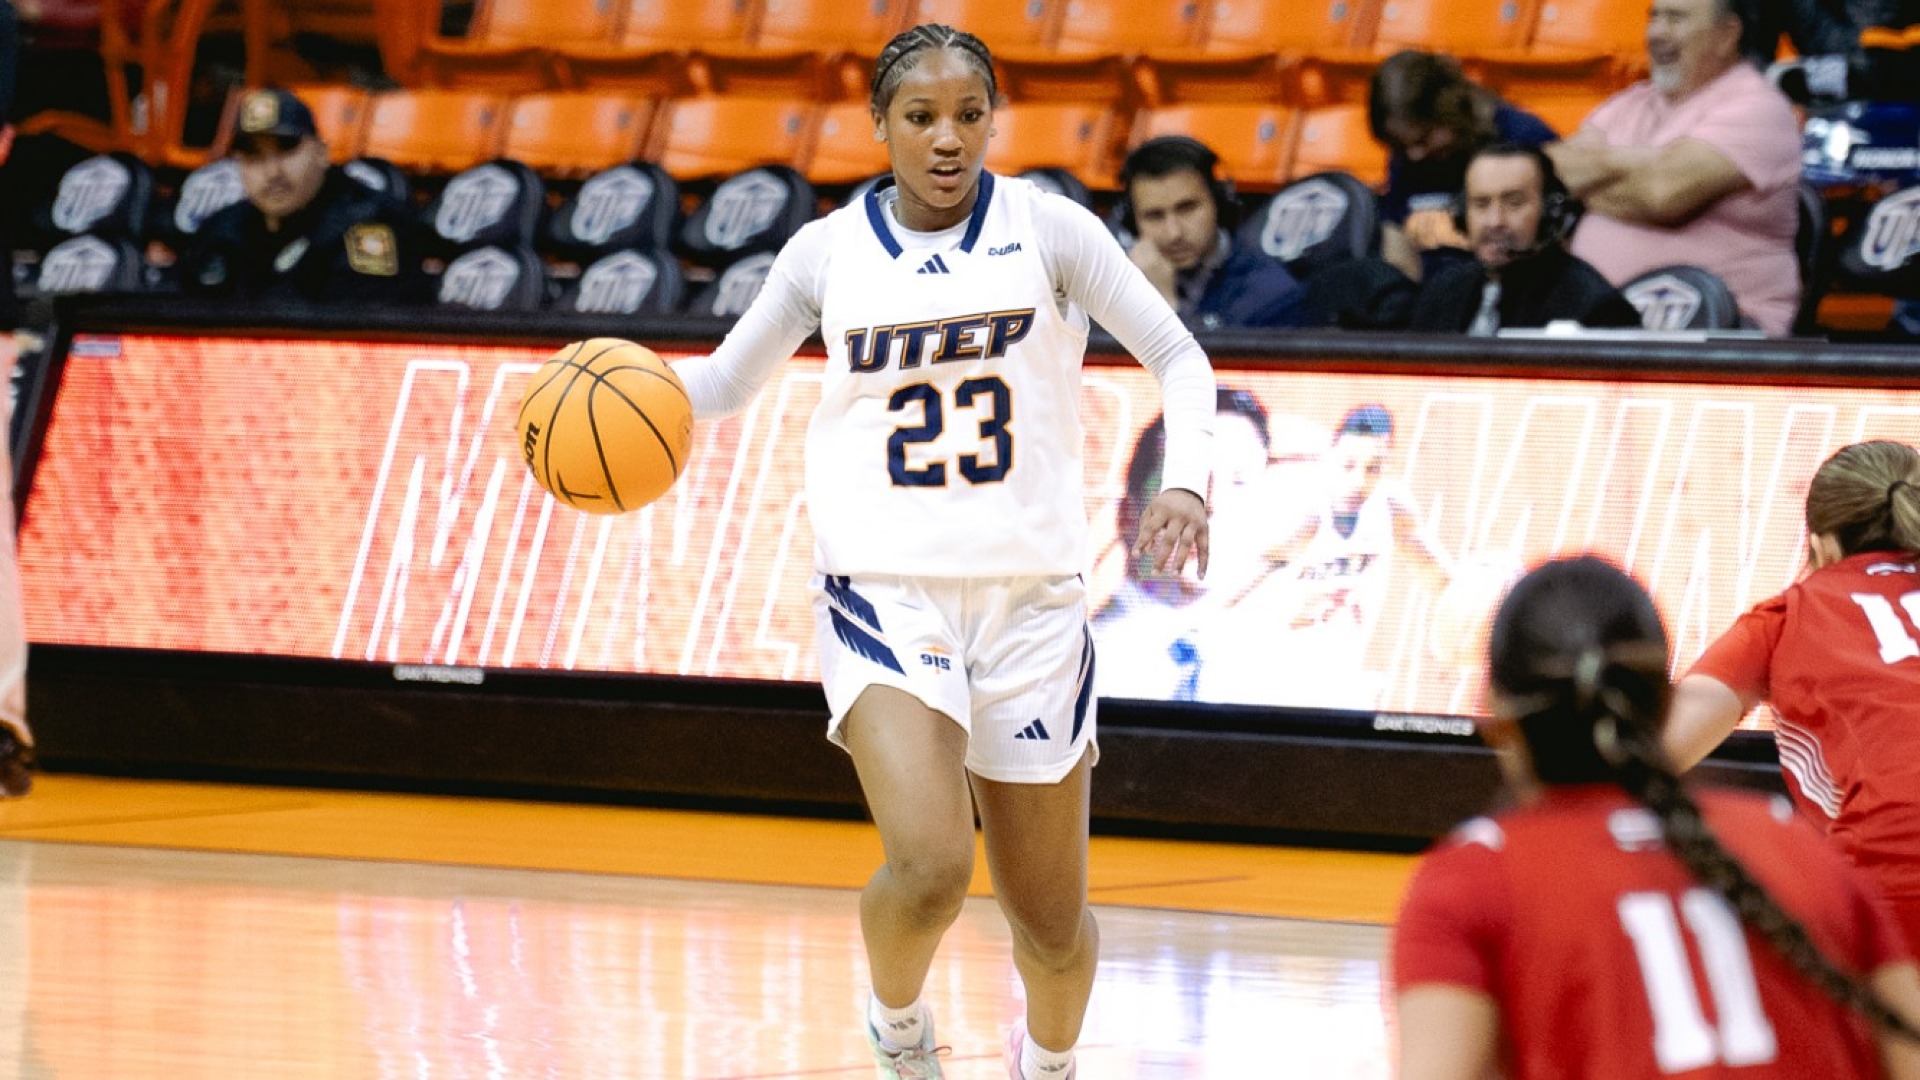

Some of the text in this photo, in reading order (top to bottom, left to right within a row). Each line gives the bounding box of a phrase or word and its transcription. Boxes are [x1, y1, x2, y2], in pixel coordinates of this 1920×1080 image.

[844, 307, 1037, 374] UTEP
[886, 373, 1015, 488] 23
[920, 653, 951, 672] 915
[1617, 888, 1779, 1074] 11
